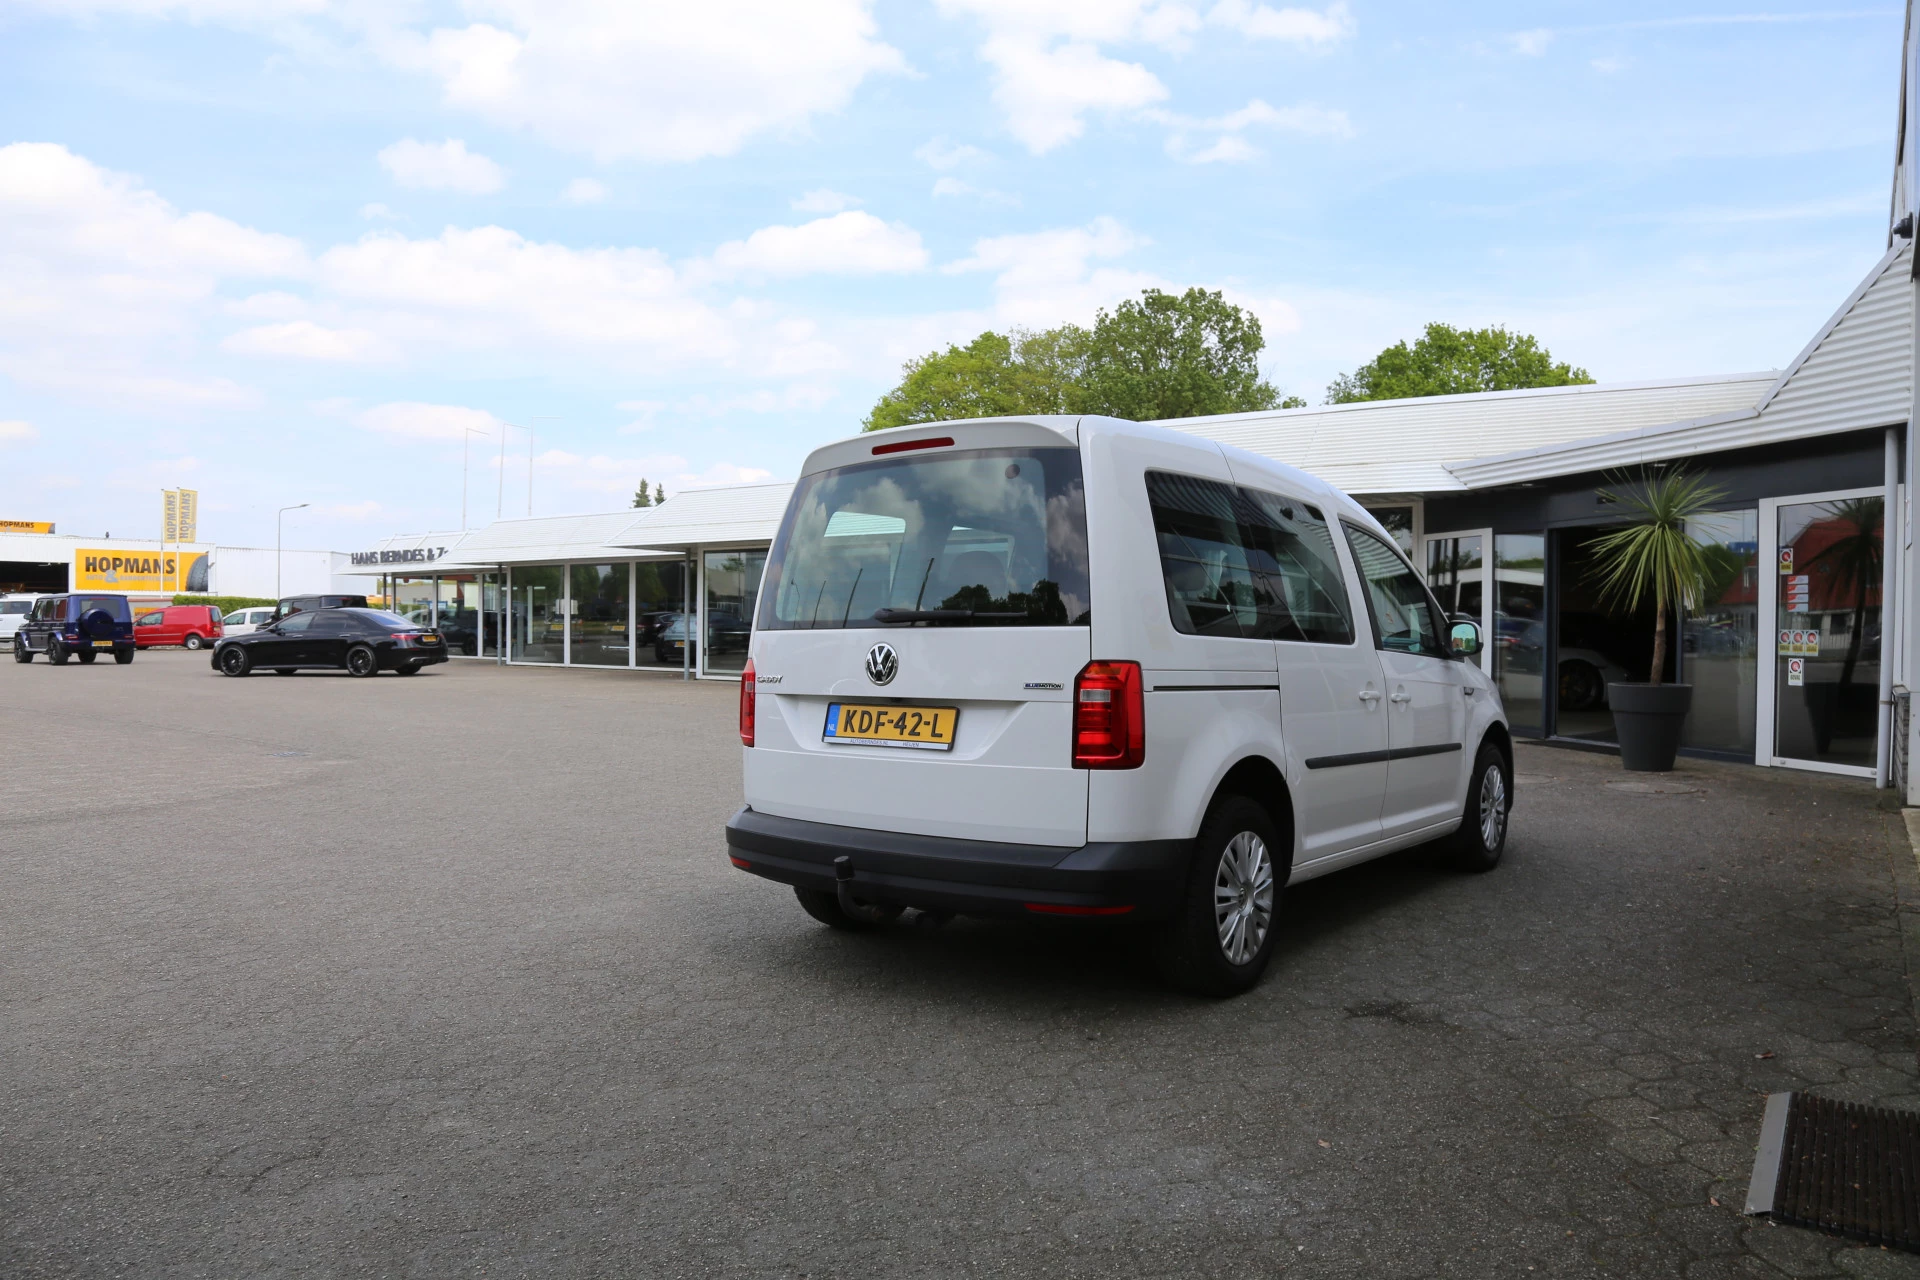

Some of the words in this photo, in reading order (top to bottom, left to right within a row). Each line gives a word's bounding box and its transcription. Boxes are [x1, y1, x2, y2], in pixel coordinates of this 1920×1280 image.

[167, 494, 176, 540] HOPMANS
[179, 493, 191, 539] HOPMANS
[85, 556, 175, 574] HOPMANS
[351, 551, 379, 565] HANS
[380, 548, 426, 564] BERNDES
[426, 548, 436, 561] &
[757, 675, 783, 684] CADDY
[827, 723, 836, 731] NL
[843, 709, 943, 739] KDF-42-L
